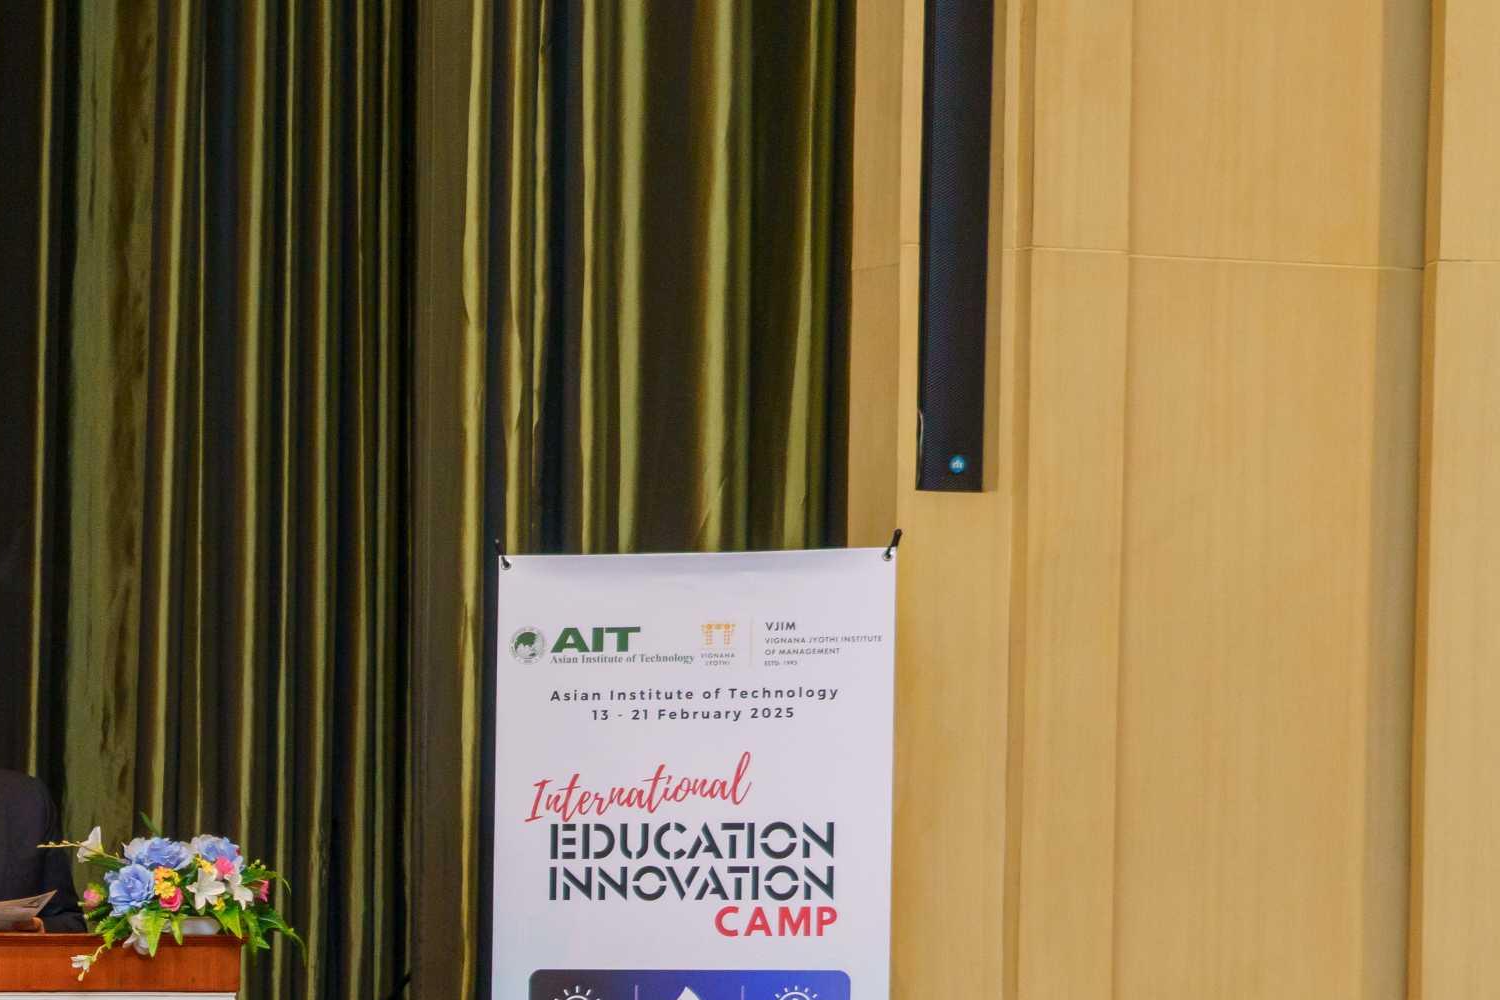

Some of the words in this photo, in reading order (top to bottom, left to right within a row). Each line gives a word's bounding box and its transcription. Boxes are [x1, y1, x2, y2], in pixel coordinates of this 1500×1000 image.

[764, 621, 797, 632] VJIM
[550, 626, 642, 653] AIT
[841, 635, 883, 643] INSTITUTE
[550, 655, 579, 665] Asian
[581, 654, 623, 665] Institute
[626, 654, 637, 664] of
[639, 653, 695, 665] Technology
[779, 648, 840, 656] MANAGEMENT
[550, 690, 601, 702] Asian
[610, 689, 694, 701] Institute
[702, 687, 721, 700] of
[728, 686, 839, 700] Technology
[592, 709, 609, 721] 13
[631, 709, 649, 720] 21
[658, 707, 742, 721] February
[750, 707, 795, 719] 2025
[525, 752, 752, 822] International
[550, 822, 835, 859] EDUCATION
[549, 865, 835, 901] INNOVATION
[714, 906, 838, 937] CAMP
